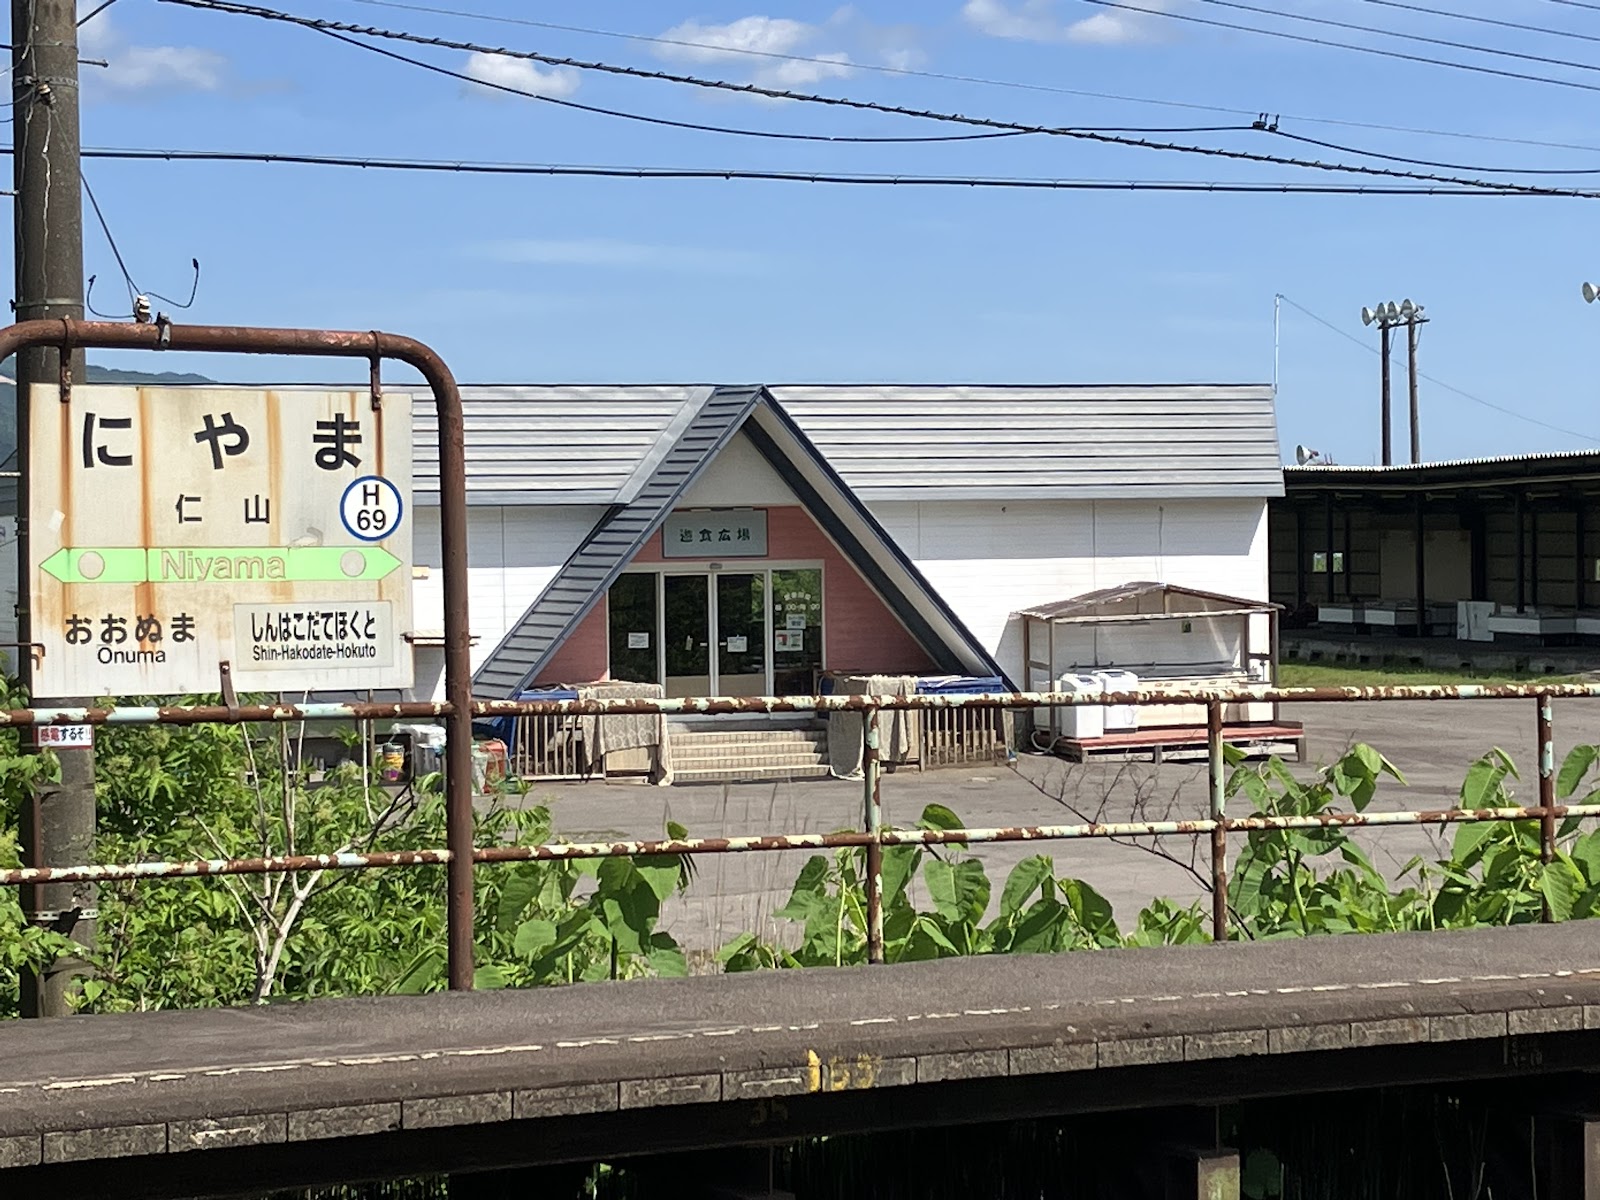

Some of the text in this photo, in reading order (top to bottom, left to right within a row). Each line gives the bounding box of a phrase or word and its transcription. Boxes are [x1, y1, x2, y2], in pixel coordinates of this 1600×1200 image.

[83, 412, 363, 470] にやま
[175, 494, 270, 524] 仁山
[363, 484, 379, 506] H
[357, 509, 386, 531] 69
[161, 550, 286, 581] Niyama
[65, 612, 195, 645] おおぬま
[251, 611, 376, 642] しんはこだてほくと
[253, 643, 376, 661] Shin-Hakodate-Hokuto
